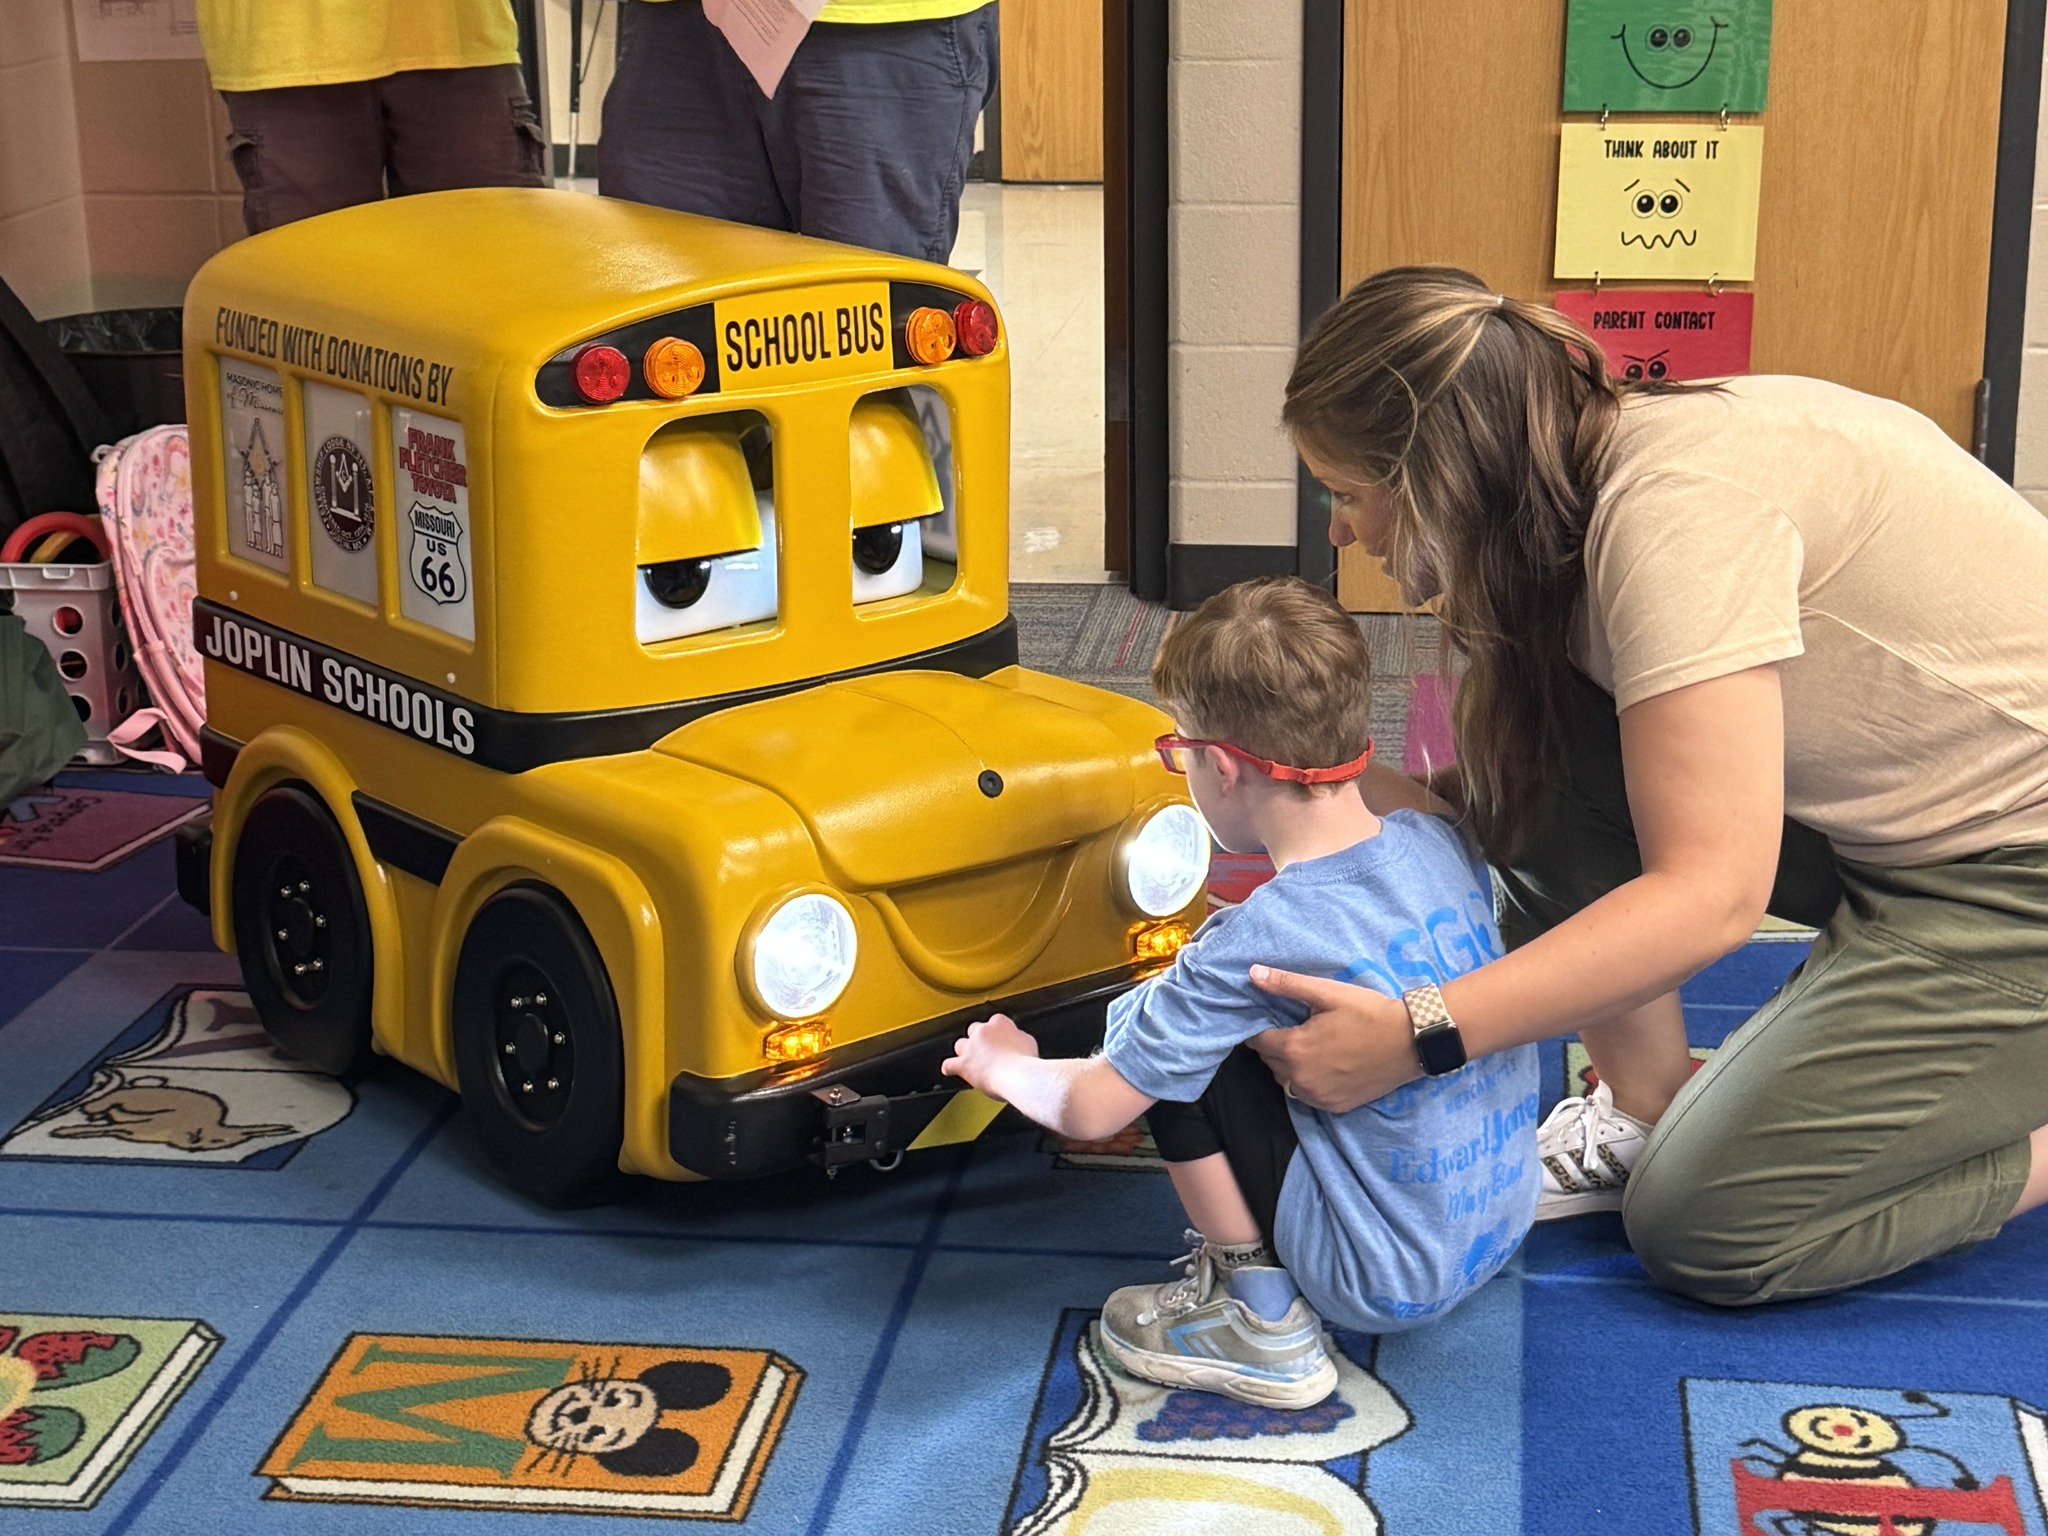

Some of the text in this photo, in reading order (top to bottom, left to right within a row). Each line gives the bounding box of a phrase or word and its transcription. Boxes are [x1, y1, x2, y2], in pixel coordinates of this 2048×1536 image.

[1604, 139, 1719, 159] THINK ABOUT IT
[725, 302, 884, 372] SCHOOL BUS
[1593, 310, 1716, 330] PARENT CONTACT
[215, 307, 453, 406] FUNDED WITH DONATIONS BY
[407, 427, 456, 462] FRANK
[399, 446, 467, 488] FLETCHER
[411, 473, 458, 504] TOYOTA
[414, 509, 455, 539] MISSOURI
[426, 538, 447, 556] US
[420, 556, 455, 598] 66
[206, 616, 475, 755] JOPLIN SCHOOLS
[286, 1343, 578, 1480] M
